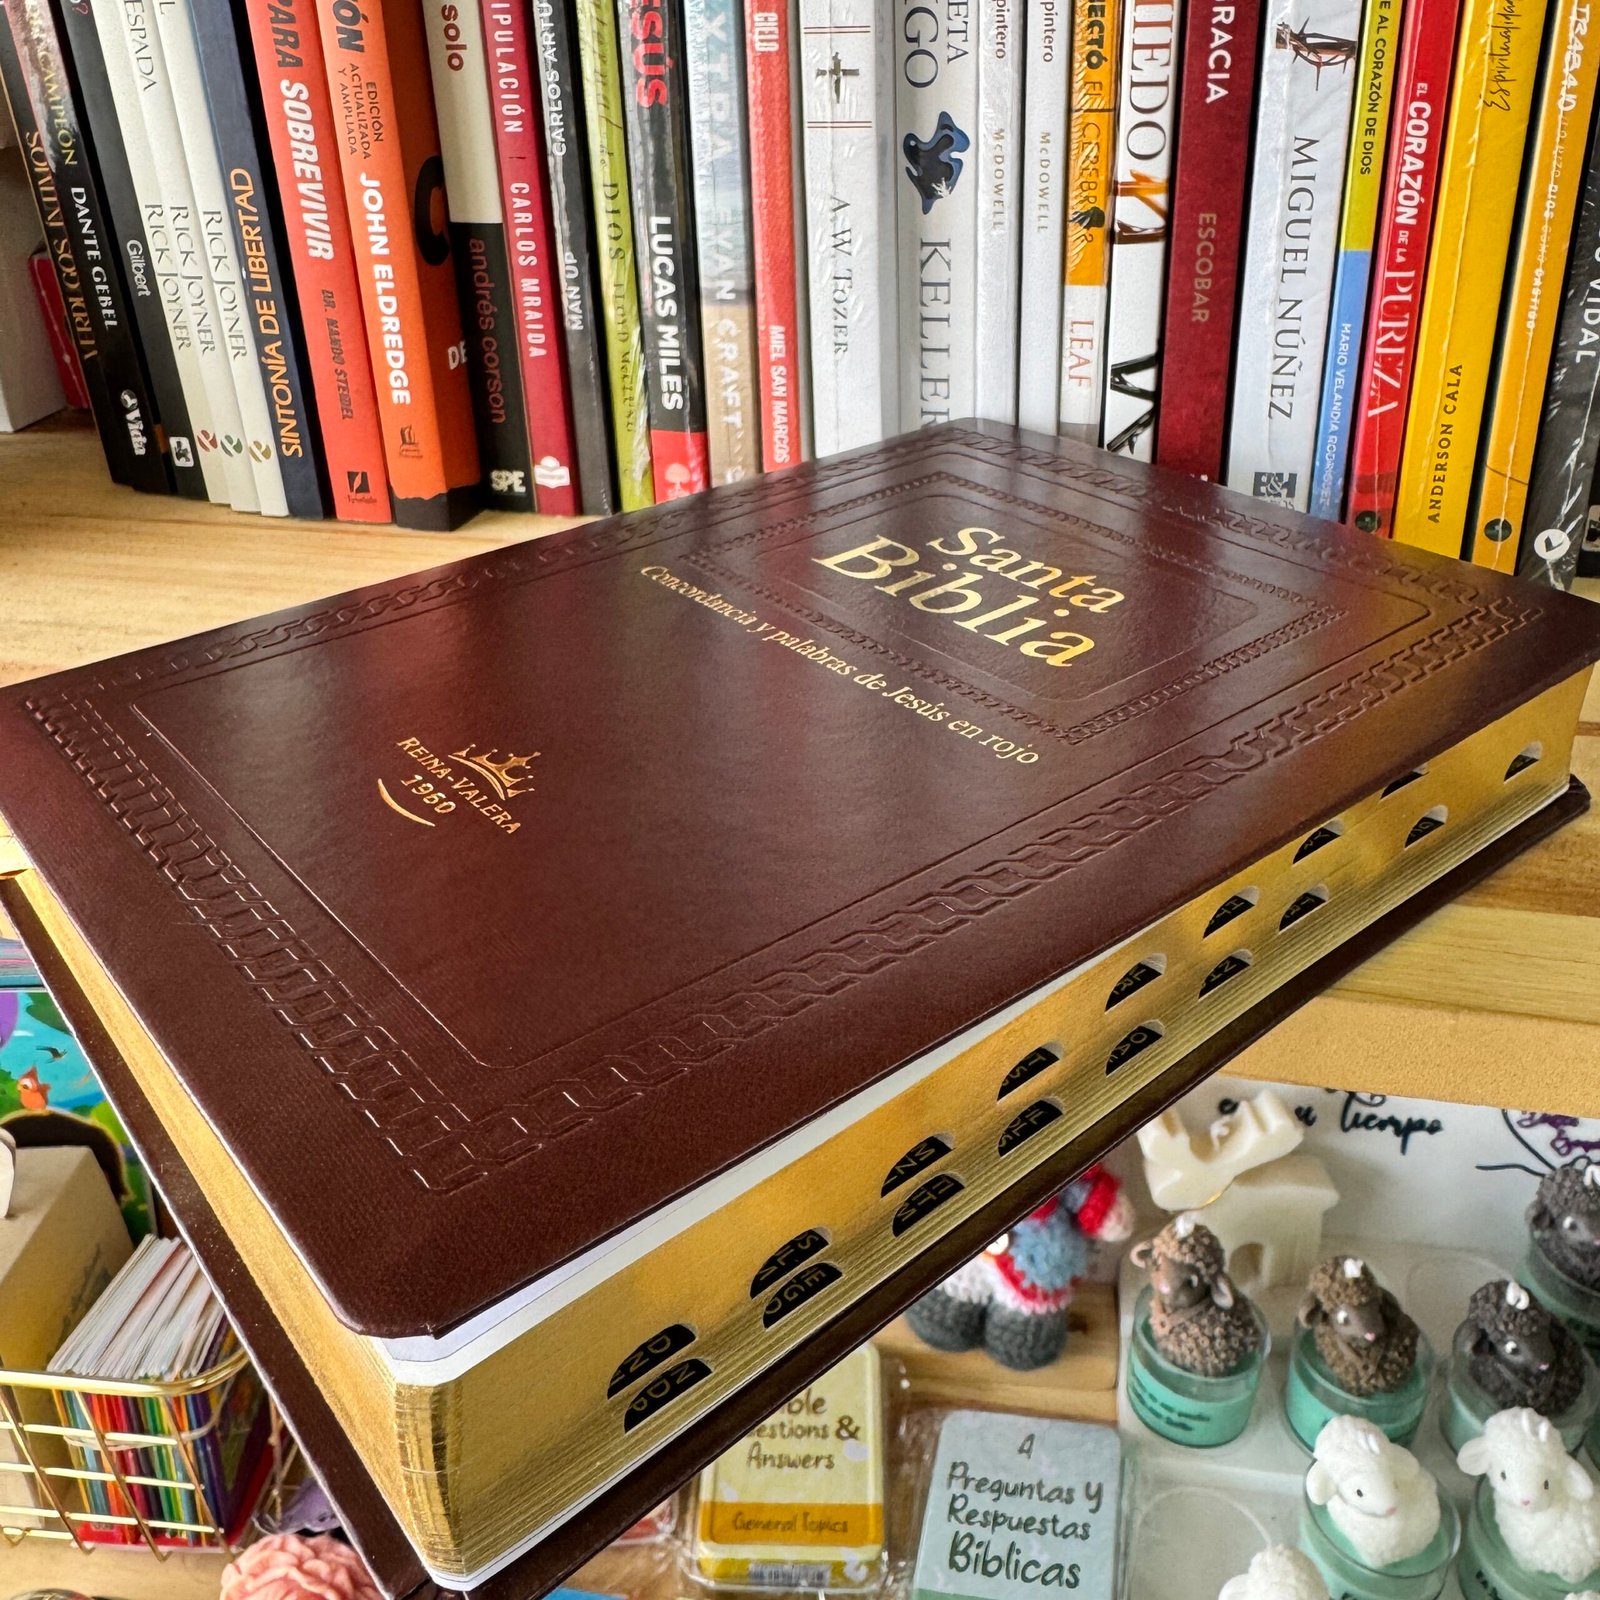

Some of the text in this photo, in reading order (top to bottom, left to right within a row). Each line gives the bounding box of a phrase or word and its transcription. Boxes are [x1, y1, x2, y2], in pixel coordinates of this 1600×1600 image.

[124, 0, 157, 91] ESPADA
[333, 0, 369, 53] ÓN
[441, 4, 467, 72] solo
[630, 0, 674, 109] SÚS
[904, 0, 939, 88] GO
[946, 0, 969, 64] ETA
[1040, 1, 1059, 63] pintero
[1085, 0, 1108, 70] ECTÓ
[1205, 0, 1236, 104] RACIA
[1376, 15, 1390, 35] AL
[338, 67, 358, 156] Y AMPLIADA
[350, 63, 372, 160] ACTUALIZADA
[366, 81, 384, 142] EDICIÓN
[1127, 0, 1174, 161] IEDO
[1368, 38, 1387, 114] CORAZÓN
[280, 79, 335, 261] SOBREVIVIR
[1360, 142, 1375, 175] DIOS
[1364, 117, 1377, 137] DE
[491, 3, 547, 358] IPULACIÓN CARLOS MRAIDA
[70, 187, 101, 261] DANTE
[91, 266, 118, 331] GEBEL
[126, 239, 151, 297] Gilbert
[144, 204, 191, 351] RICK JOYNER
[169, 206, 215, 355] RICK JOYNER
[203, 210, 248, 361] RICK JOYNER
[360, 172, 411, 405] JOHN ELDREDGE
[564, 251, 584, 331] MAN UP
[1192, 212, 1217, 323] ESCOBAR
[1268, 136, 1320, 420] MIGUEL NÚÑEZ
[1367, 82, 1432, 417] EL CORAZÓN DE LA PUREZA
[230, 168, 303, 458] SINTONÍA DE LIBERTAD
[469, 237, 506, 425] andrés corson
[649, 216, 684, 411] LUCAS MILES
[832, 268, 852, 355] TOZER
[920, 238, 951, 430] KELLER
[1068, 320, 1095, 388] LEAF
[1337, 323, 1352, 366] MARIO
[716, 317, 742, 426] CRAFT
[768, 325, 790, 464] MIEL SAN MARCOS
[1328, 368, 1346, 433] VELANDIA
[1428, 364, 1463, 524] ANDERSON CALA
[810, 534, 1098, 668] Biblia
[926, 526, 1126, 615] Santa
[640, 565, 1039, 764] Concordancia y palabras de Jesús en rojo
[396, 736, 522, 834] REINA-VALERA
[400, 774, 456, 814] 1960
[746, 1415, 861, 1441] estions &
[746, 1440, 835, 1470] Answers
[732, 1510, 798, 1533] General
[947, 1461, 1076, 1505] Preguntas
[947, 1494, 1092, 1541] Respuestas
